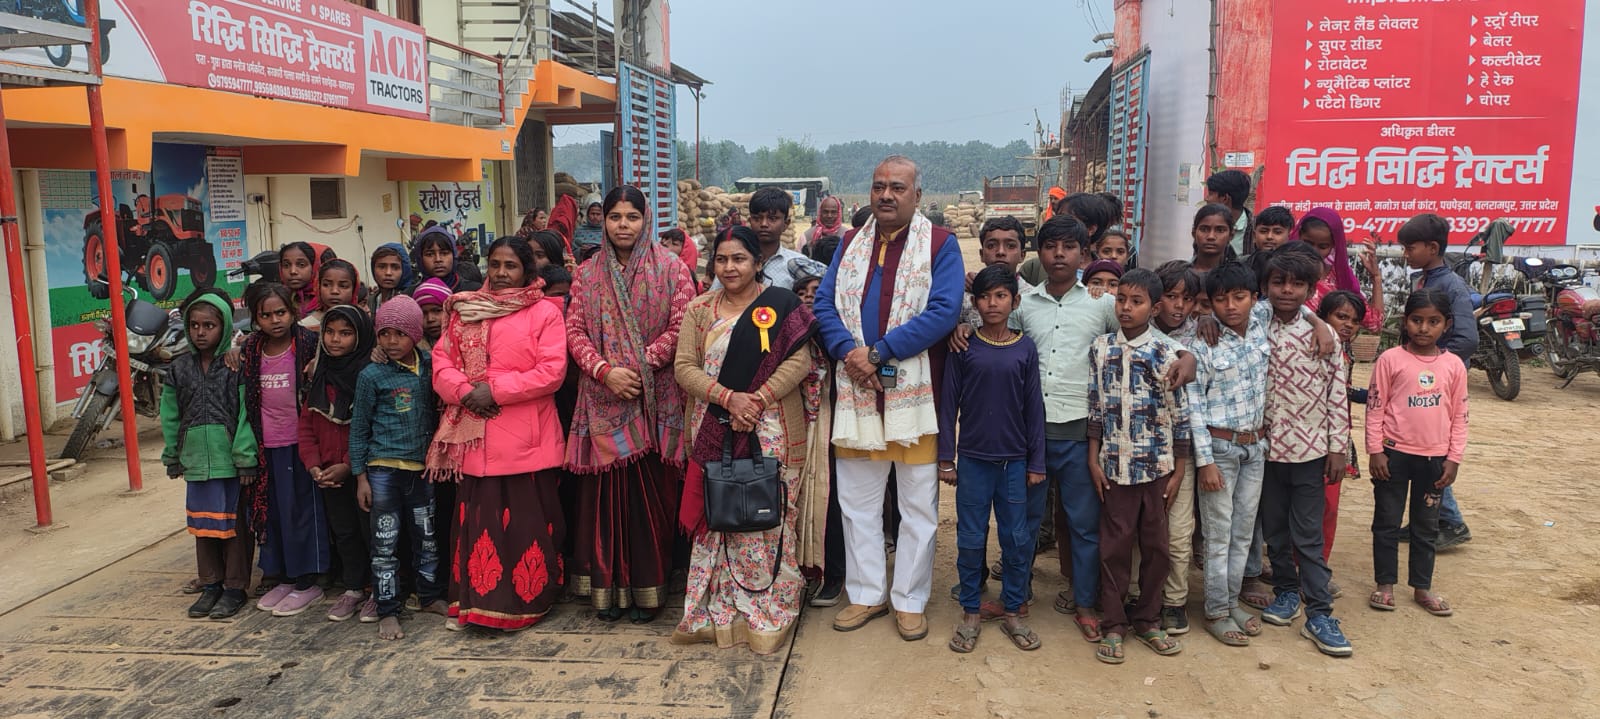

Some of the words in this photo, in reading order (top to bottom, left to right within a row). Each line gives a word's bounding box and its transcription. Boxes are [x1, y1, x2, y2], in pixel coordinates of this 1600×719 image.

[262, 0, 301, 13] RVICE
[319, 5, 351, 27] SPARES
[1354, 15, 1375, 31] लैंड
[1379, 14, 1419, 30] लेवलर
[1483, 11, 1508, 30] स्ट्रॉ
[1509, 11, 1539, 27] रीपर
[188, 0, 246, 52] रिद्धि
[248, 15, 304, 63] सिद्धि
[303, 28, 356, 73] ट्रैक्टर्स
[1318, 39, 1347, 55] सुपर
[1350, 35, 1383, 50] सीडर
[1482, 31, 1512, 47] बेलर
[370, 29, 422, 83] ACE
[1317, 55, 1367, 70] रोटावेटर
[1481, 51, 1542, 67] कल्टीवेटर
[1316, 74, 1370, 93] न्यूमैटिक
[1373, 74, 1411, 89] प्लांटर
[1480, 71, 1489, 88] हे
[1493, 71, 1514, 86] रेक
[370, 79, 423, 104] TRACTORS
[1315, 94, 1346, 109] पटैटो
[1349, 93, 1381, 109] डिगर
[1380, 123, 1424, 139] अधिकृत
[1426, 123, 1456, 137] डीलर
[1285, 147, 1360, 189] रिद्धि
[1364, 146, 1449, 188] सिद्धि
[1452, 145, 1550, 188] ट्रैक्टर्स
[418, 184, 451, 212] रमेश
[1335, 199, 1344, 211] के
[1345, 200, 1372, 213] सामने,
[1374, 199, 1399, 211] मनोज
[1401, 198, 1416, 211] धर्म
[1474, 200, 1518, 213] बलरामपुर,
[1519, 200, 1537, 211] उत्तर
[1538, 198, 1559, 211] प्रदेश
[1408, 394, 1442, 408] NOISY
